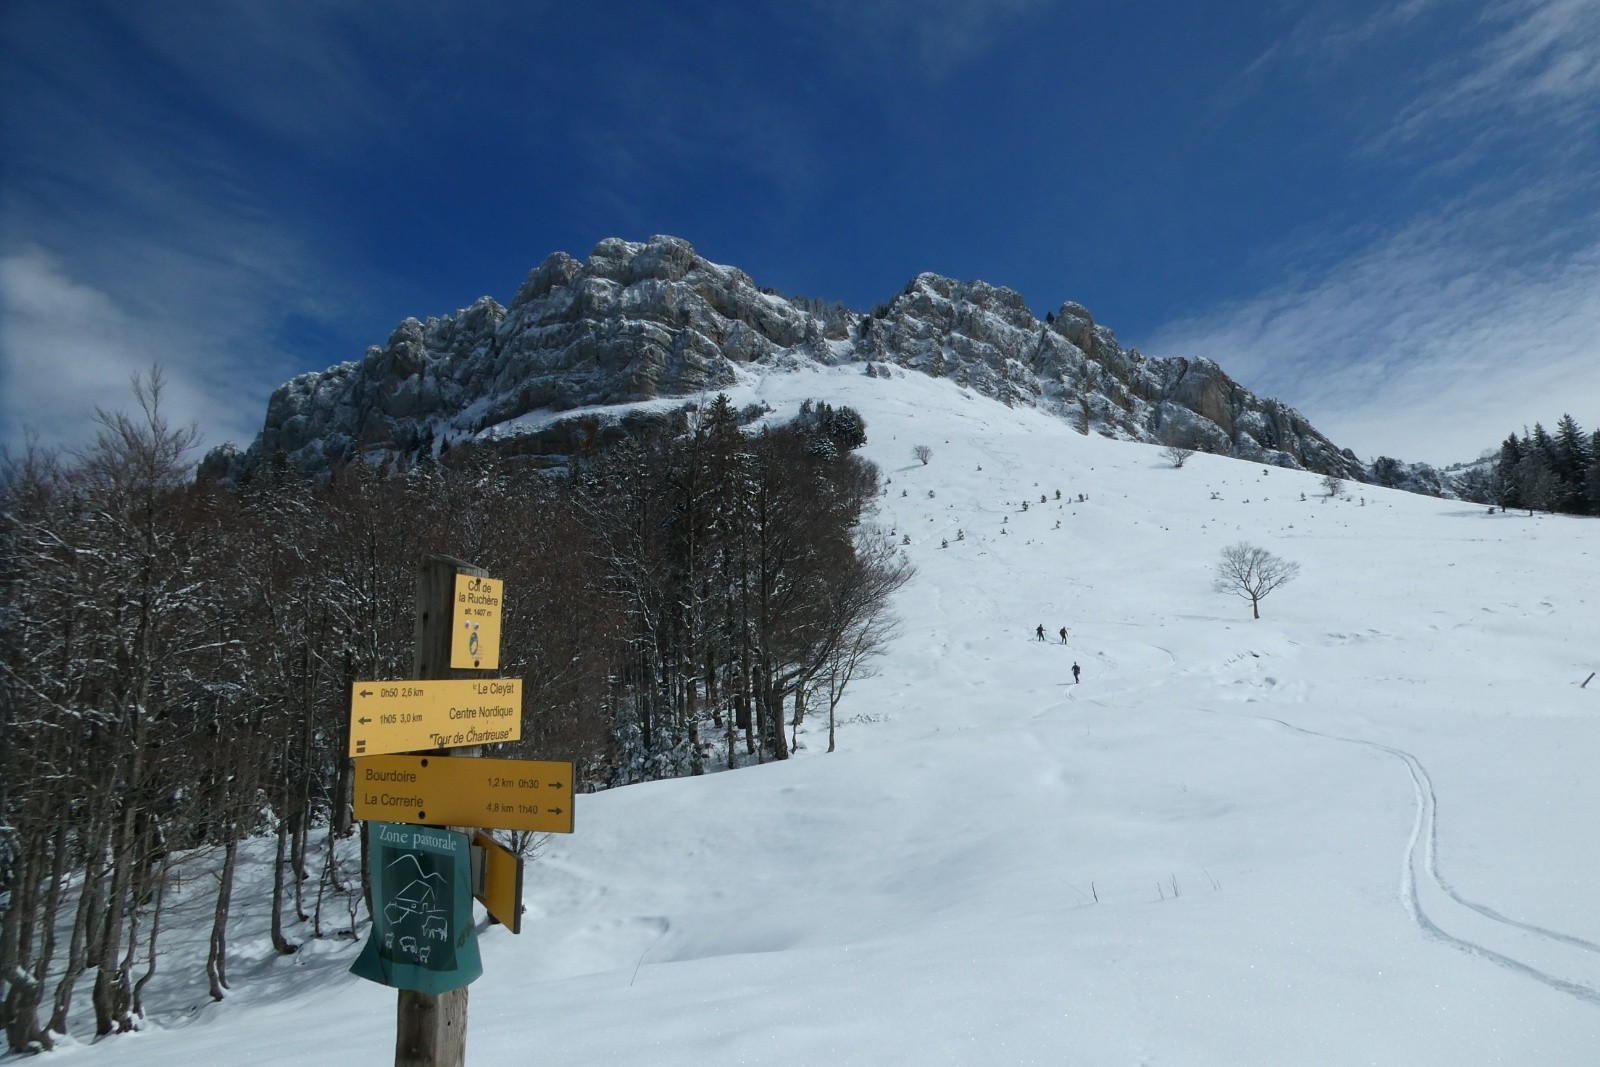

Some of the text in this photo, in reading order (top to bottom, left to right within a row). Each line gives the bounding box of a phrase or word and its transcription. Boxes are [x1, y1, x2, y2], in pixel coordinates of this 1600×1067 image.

[468, 580, 492, 593] Col de
[459, 592, 498, 606] la Ruchère
[474, 609, 487, 617] 1407
[380, 687, 424, 698] 0h50 2,6 km
[477, 683, 488, 694] Le
[380, 713, 423, 725] 1h05 3,0 km
[449, 705, 514, 721] Centre Nordique
[453, 732, 464, 744] de
[365, 768, 417, 783] Bourdoire
[487, 777, 540, 790] 1,2 km 0h30
[364, 793, 424, 808] La Correrie
[501, 803, 514, 813] km
[518, 803, 539, 815] 1h40
[379, 825, 457, 851] Zone pastorale
